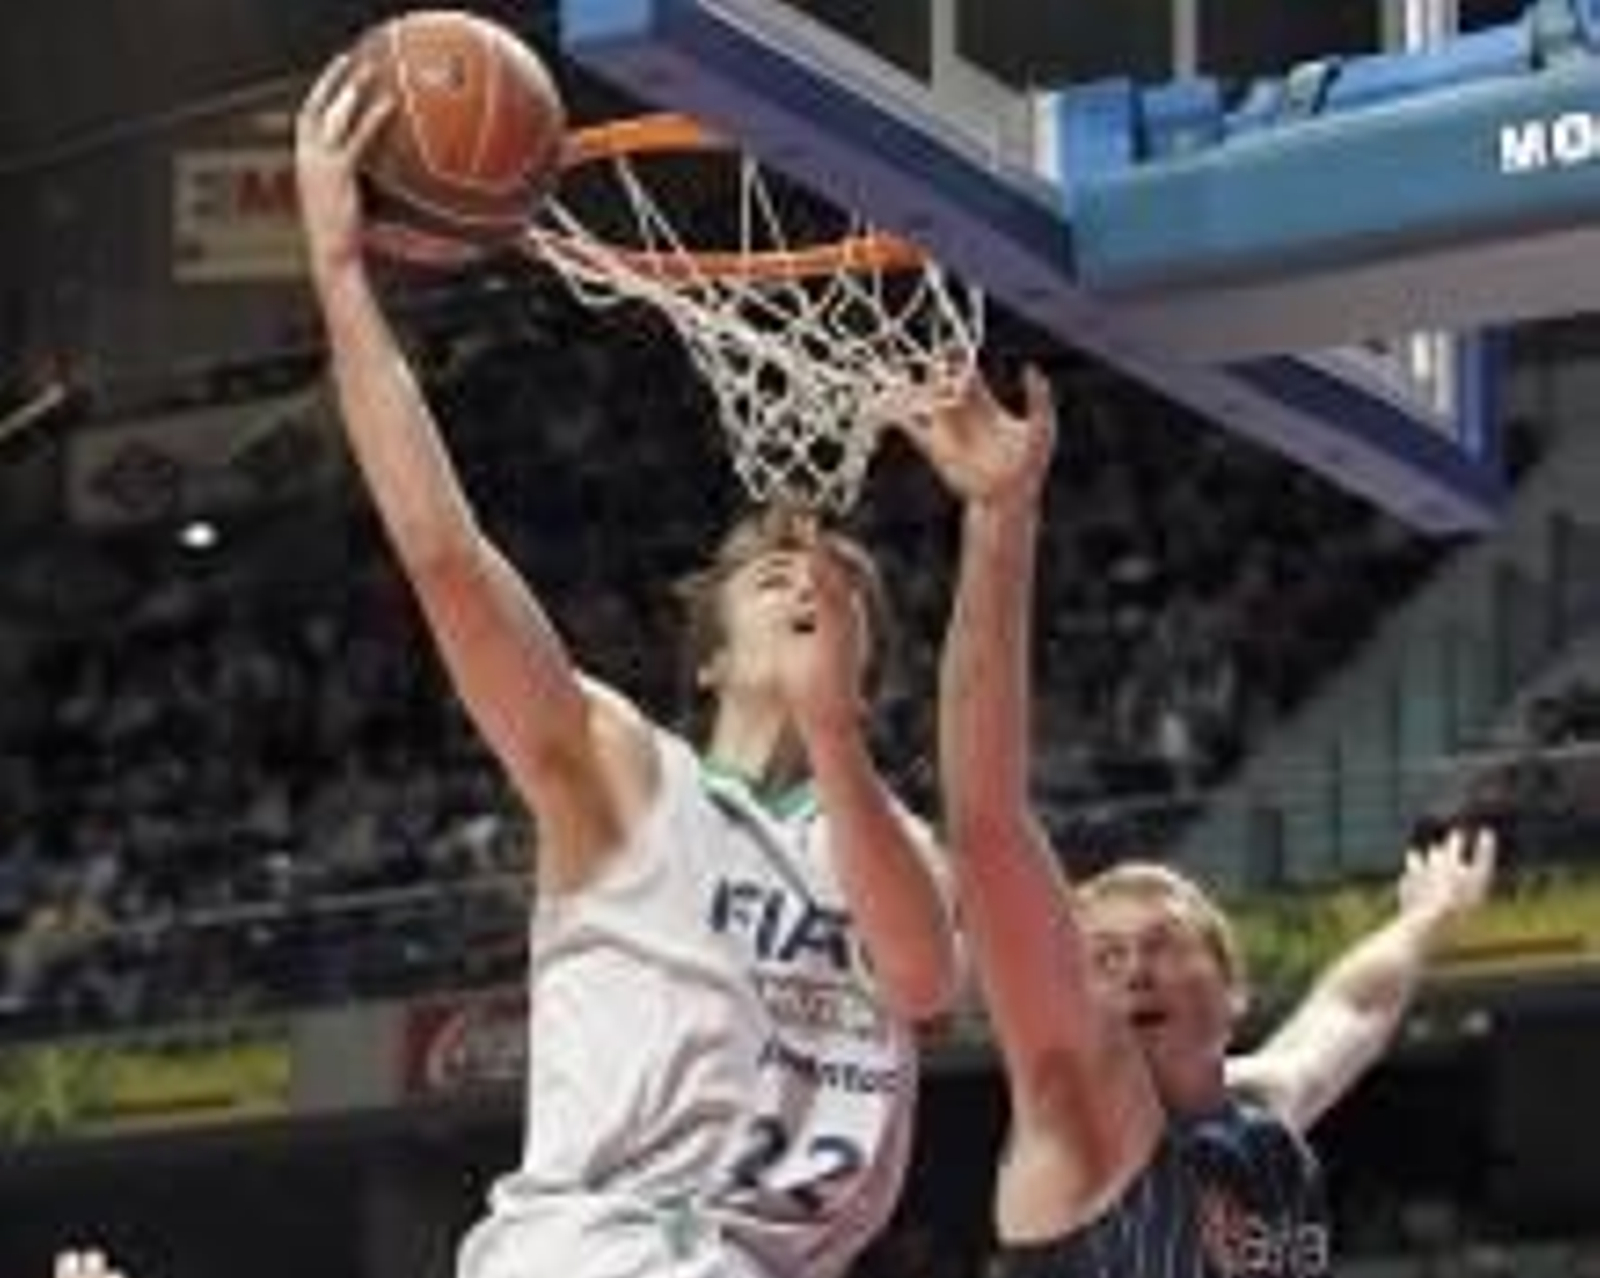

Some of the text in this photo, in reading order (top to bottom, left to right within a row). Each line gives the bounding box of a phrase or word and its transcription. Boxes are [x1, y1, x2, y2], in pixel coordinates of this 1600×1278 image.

[1500, 112, 1600, 174] MO
[706, 877, 862, 971] FIA
[725, 1115, 866, 1210] 22
